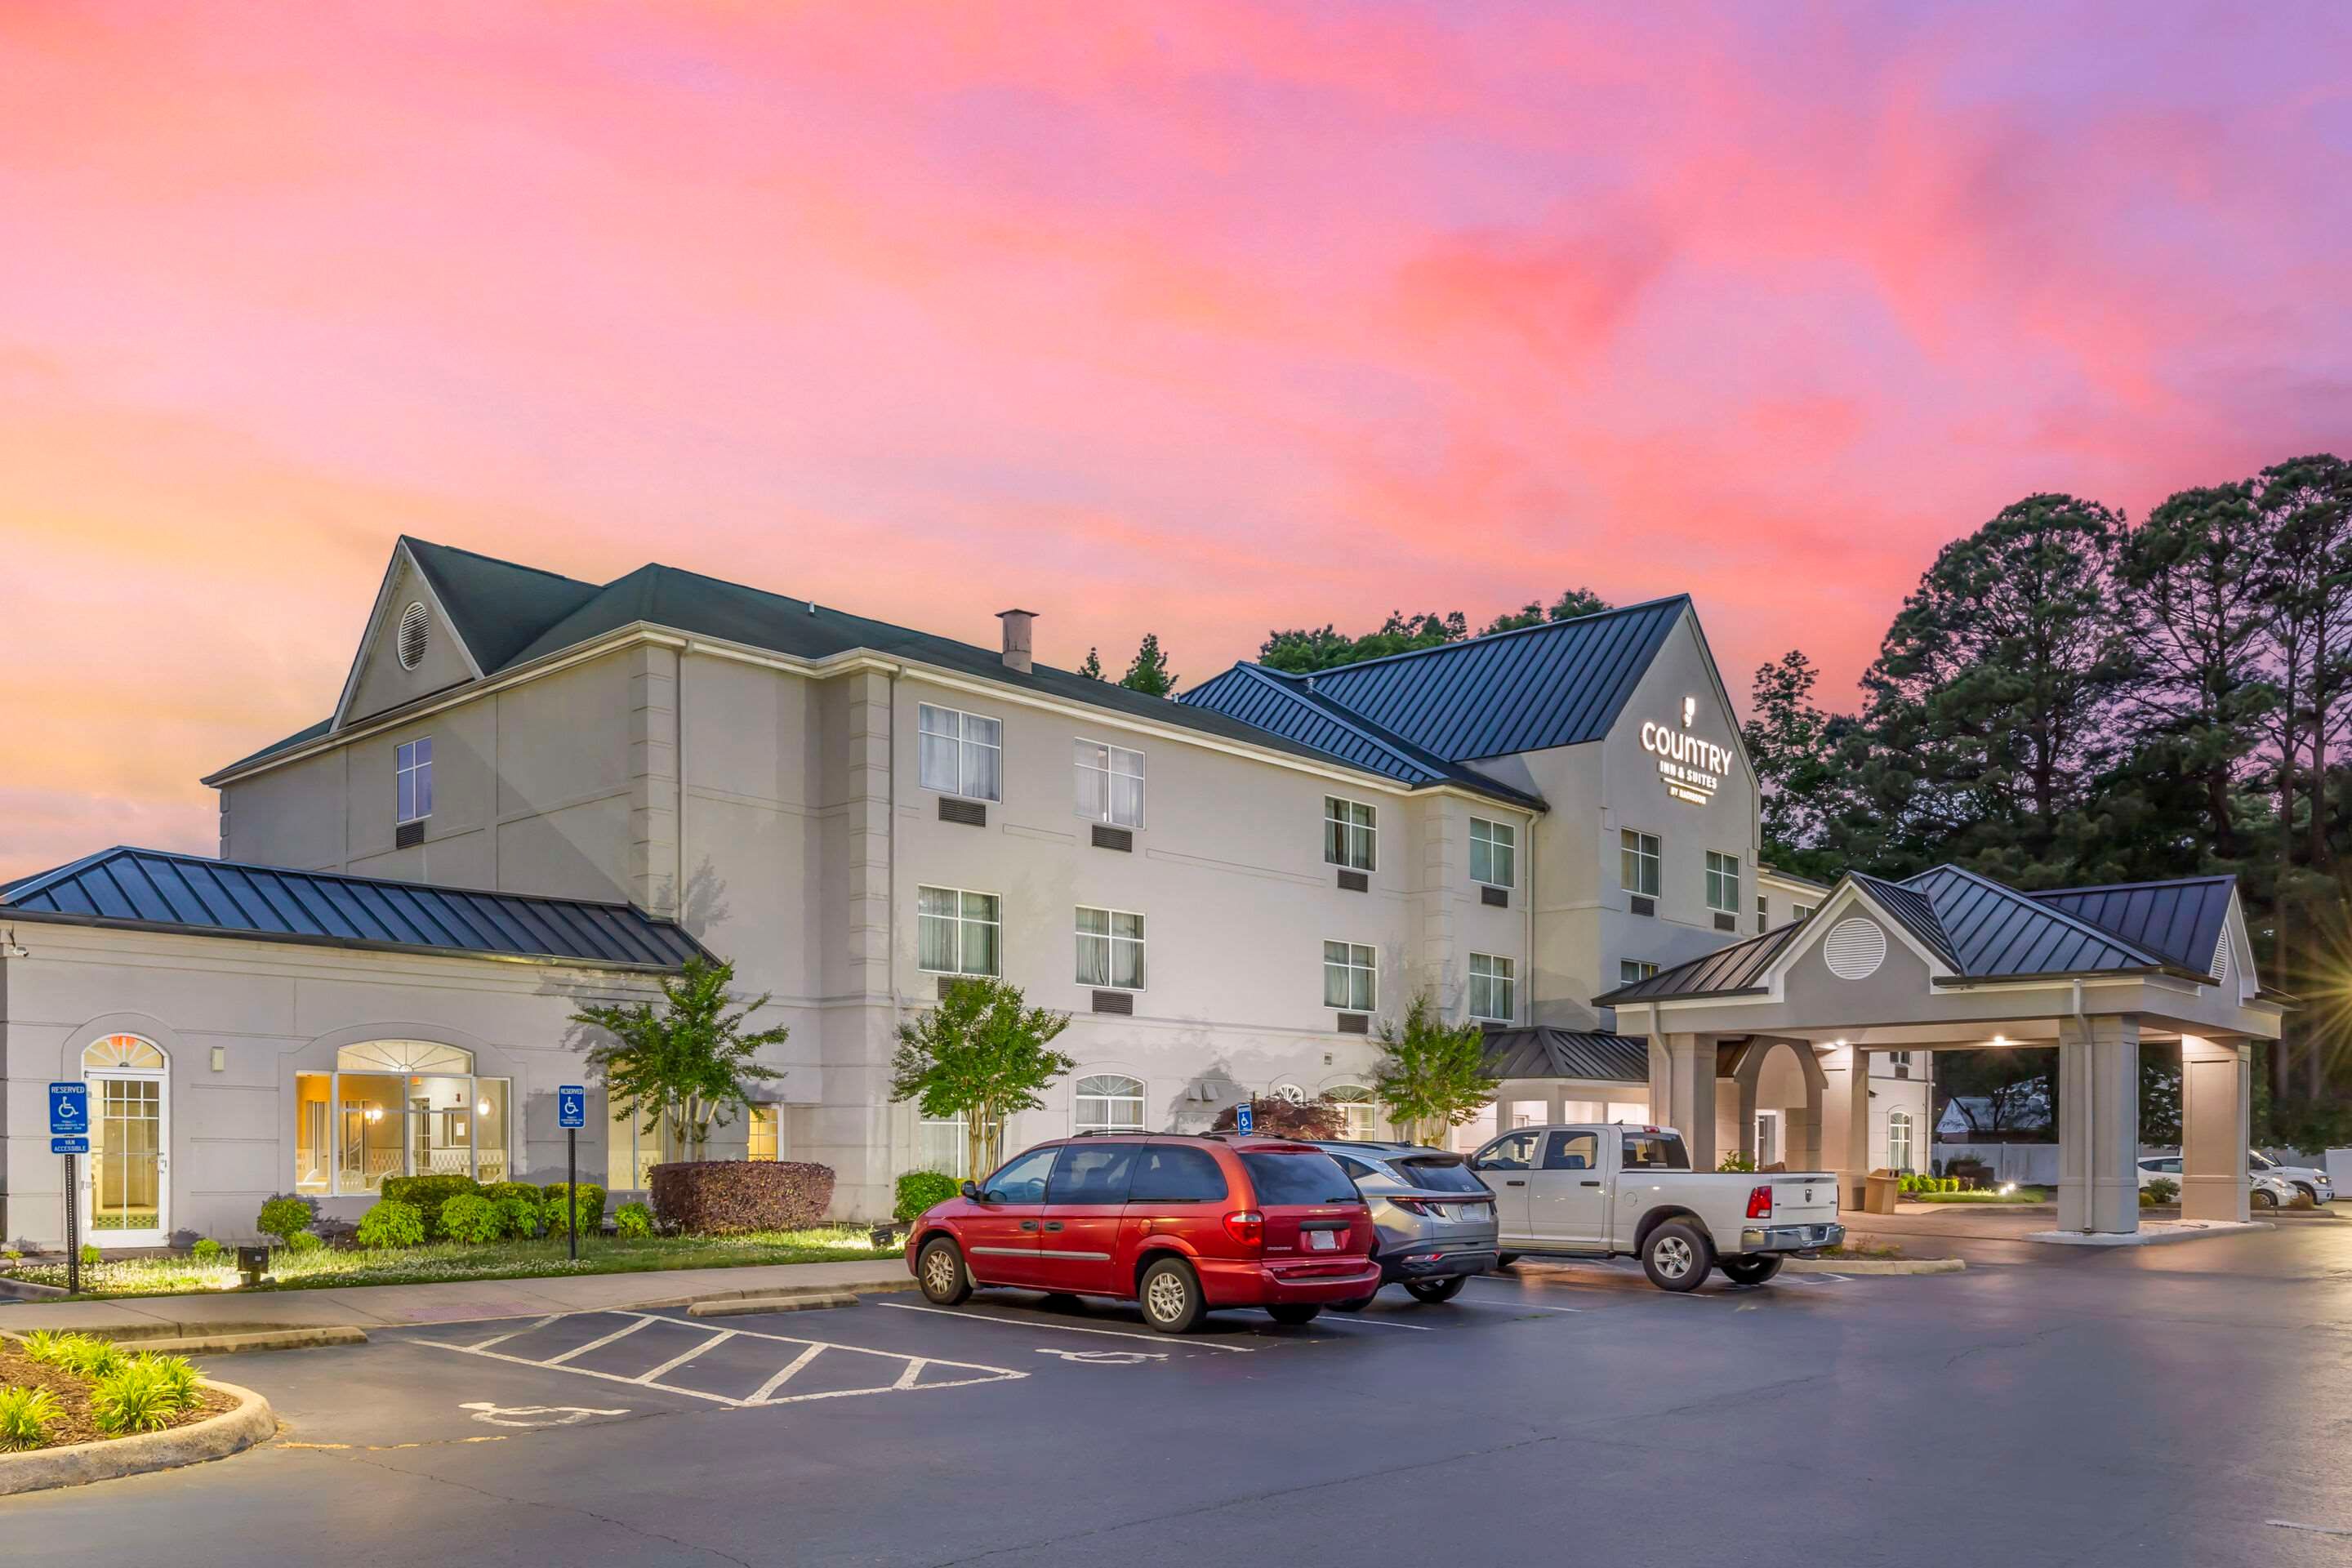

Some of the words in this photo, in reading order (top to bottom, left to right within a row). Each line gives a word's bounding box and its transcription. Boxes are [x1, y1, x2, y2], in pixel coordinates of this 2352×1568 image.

[1660, 760, 1676, 777] INN
[1677, 766, 1685, 779] &
[1686, 769, 1717, 790] SUITES
